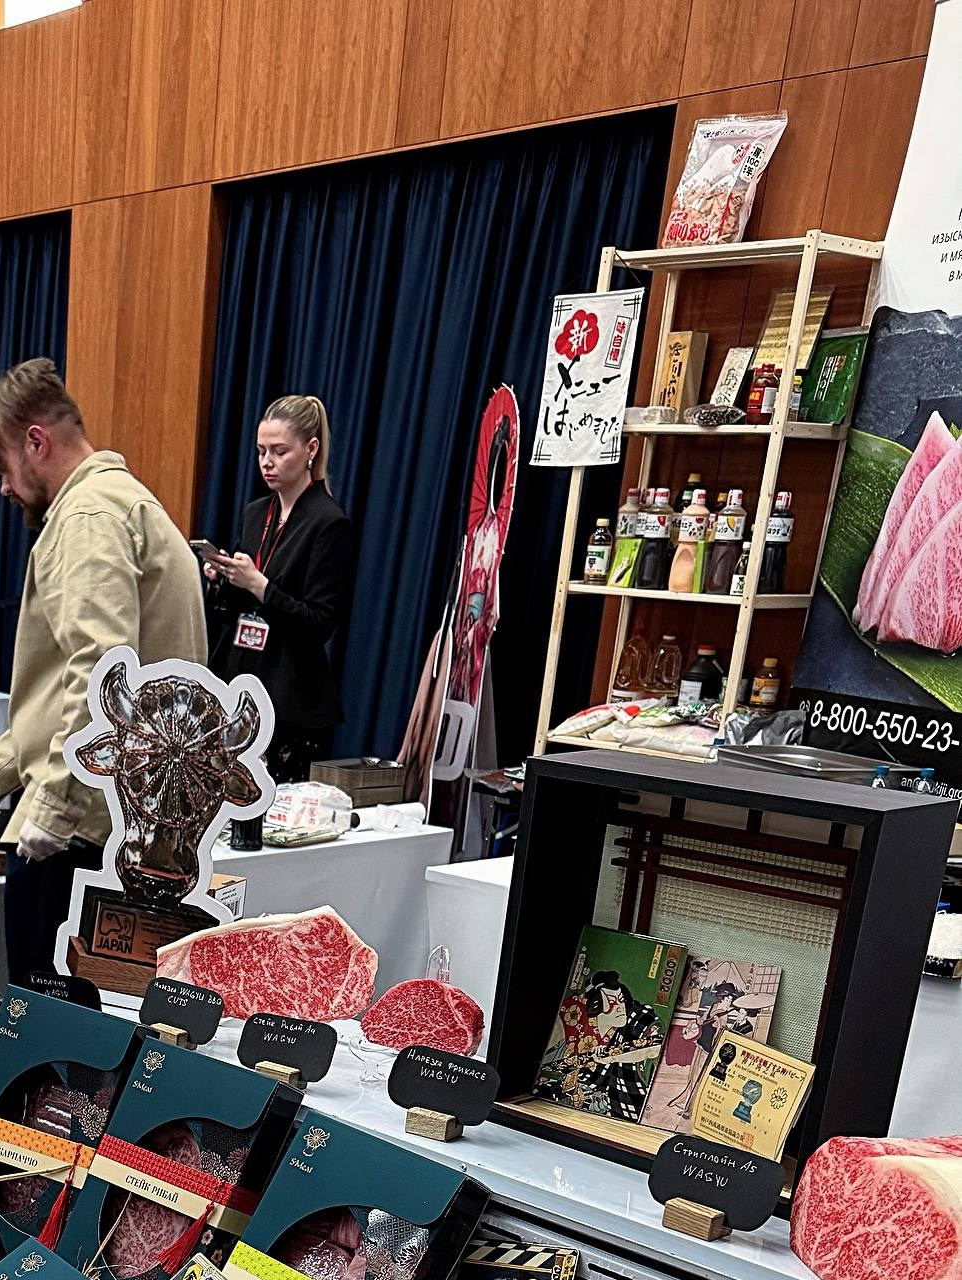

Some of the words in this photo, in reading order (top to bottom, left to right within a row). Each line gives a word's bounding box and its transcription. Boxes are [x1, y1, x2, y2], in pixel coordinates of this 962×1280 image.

[568, 318, 593, 354] 新
[554, 354, 622, 402] メニュー
[543, 399, 620, 445] はじめました
[96, 936, 133, 955] JAPAN
[167, 994, 189, 1008] CUTS
[179, 986, 205, 1002] WAGYU
[263, 1031, 298, 1045] WAGYU
[420, 1065, 460, 1085] WAGYU
[682, 1164, 729, 1187] WAGYU
[125, 1174, 151, 1193] СТЕЙК
[151, 1184, 179, 1204] РИБАЙ
